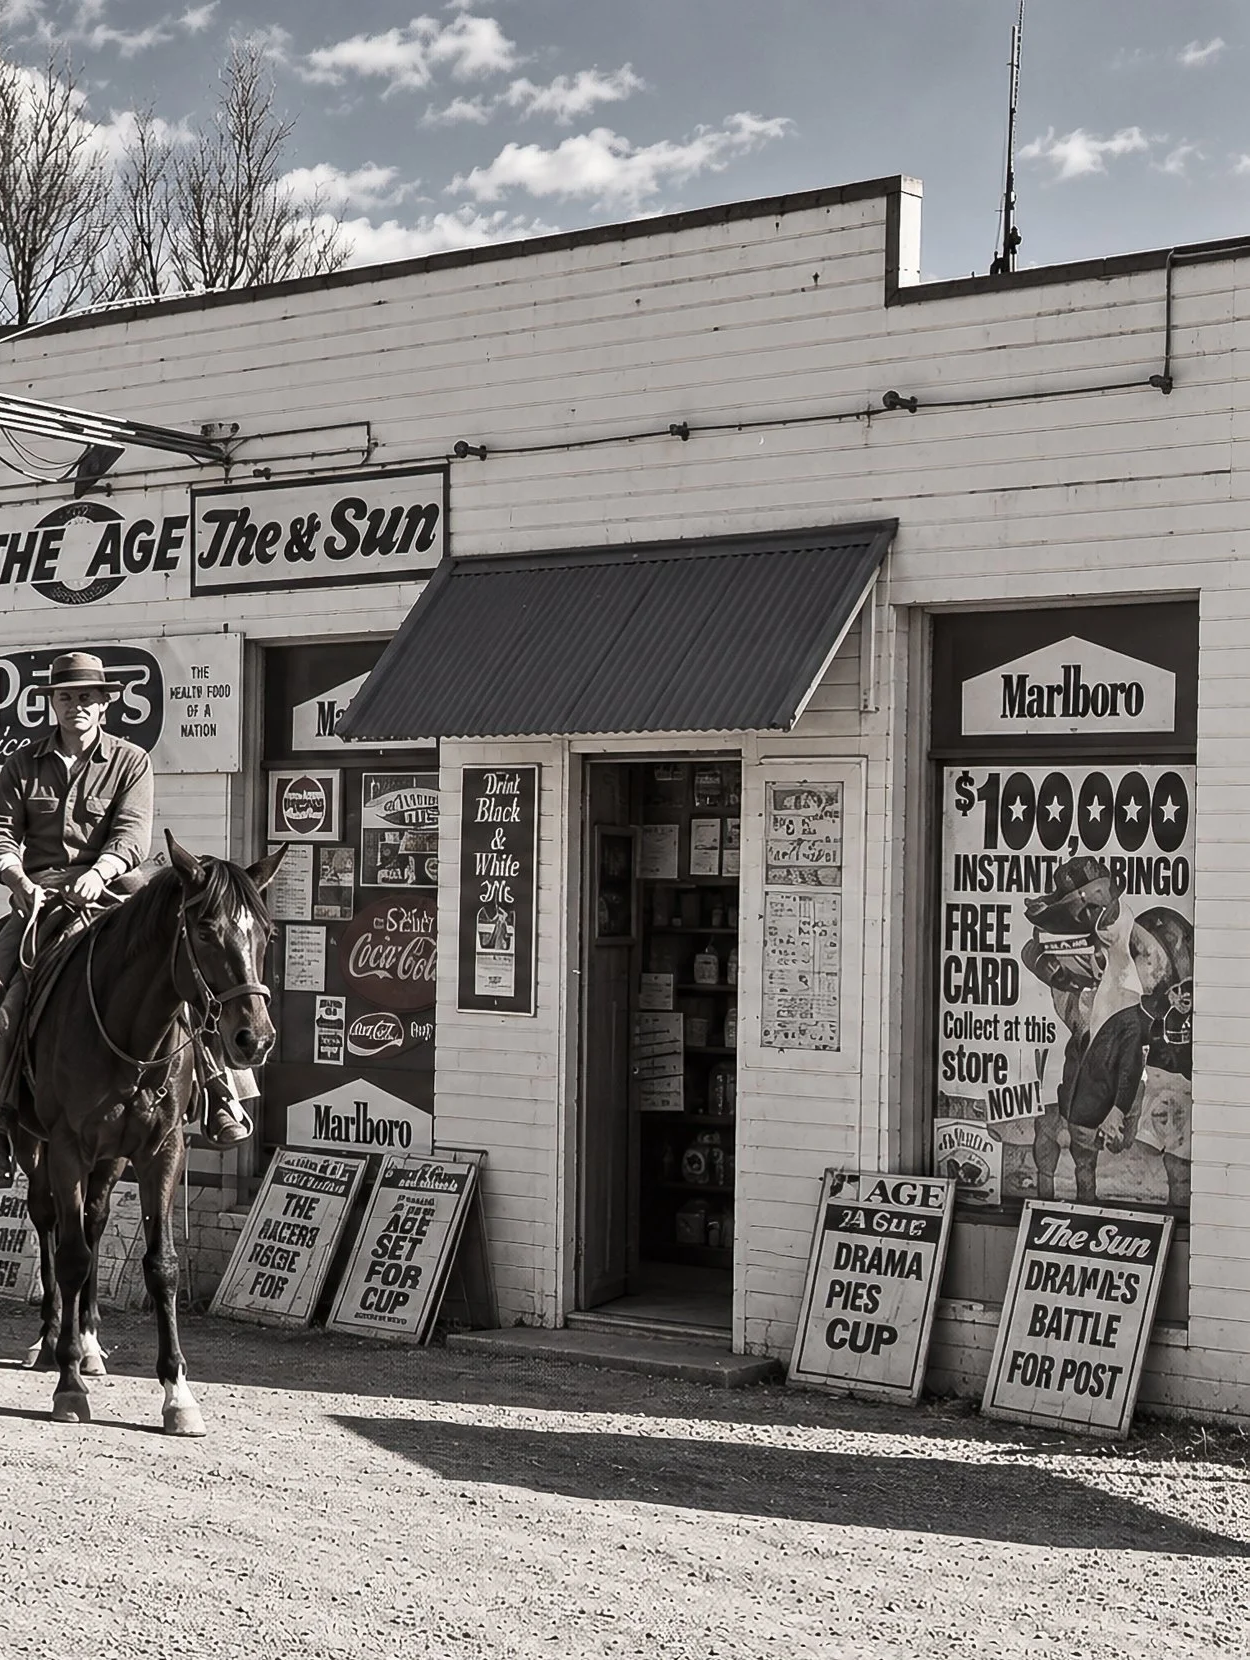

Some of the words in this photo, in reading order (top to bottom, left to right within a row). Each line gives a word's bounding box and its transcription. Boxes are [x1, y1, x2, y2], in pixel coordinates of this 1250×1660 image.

[84, 515, 190, 577] AGE
[324, 497, 440, 561] Sun
[191, 666, 209, 679] THE
[207, 684, 231, 698] FOOD
[1000, 664, 1145, 719] Marlboro
[204, 703, 211, 718] A
[180, 723, 217, 738] NATION
[954, 770, 1189, 857] $100,000
[491, 827, 506, 850] &
[474, 852, 520, 877] White
[953, 853, 1057, 894] INSTANT
[1110, 856, 1189, 896] BINGO
[944, 903, 1012, 953] FREE
[943, 954, 1019, 1006] CARD
[943, 1010, 1000, 1041] Collect
[1004, 1015, 1021, 1042] at
[1024, 1015, 1056, 1044] this
[942, 1044, 1008, 1085] store
[988, 1081, 1043, 1121] NOW!
[312, 1101, 412, 1149] Marlboro
[282, 1192, 321, 1220] THE
[863, 1179, 946, 1210] AGE
[371, 1233, 423, 1261] SET
[1034, 1216, 1089, 1250] The
[1089, 1224, 1152, 1259] Sun
[364, 1260, 423, 1289] FOR
[833, 1241, 923, 1281] DRAMA
[249, 1271, 290, 1299] FOR
[359, 1286, 410, 1314] CUP
[825, 1278, 882, 1314] PIES
[825, 1317, 898, 1356] CUP
[1027, 1303, 1122, 1349] BATTLE
[1007, 1350, 1056, 1389] FOR
[1057, 1358, 1123, 1400] POST
